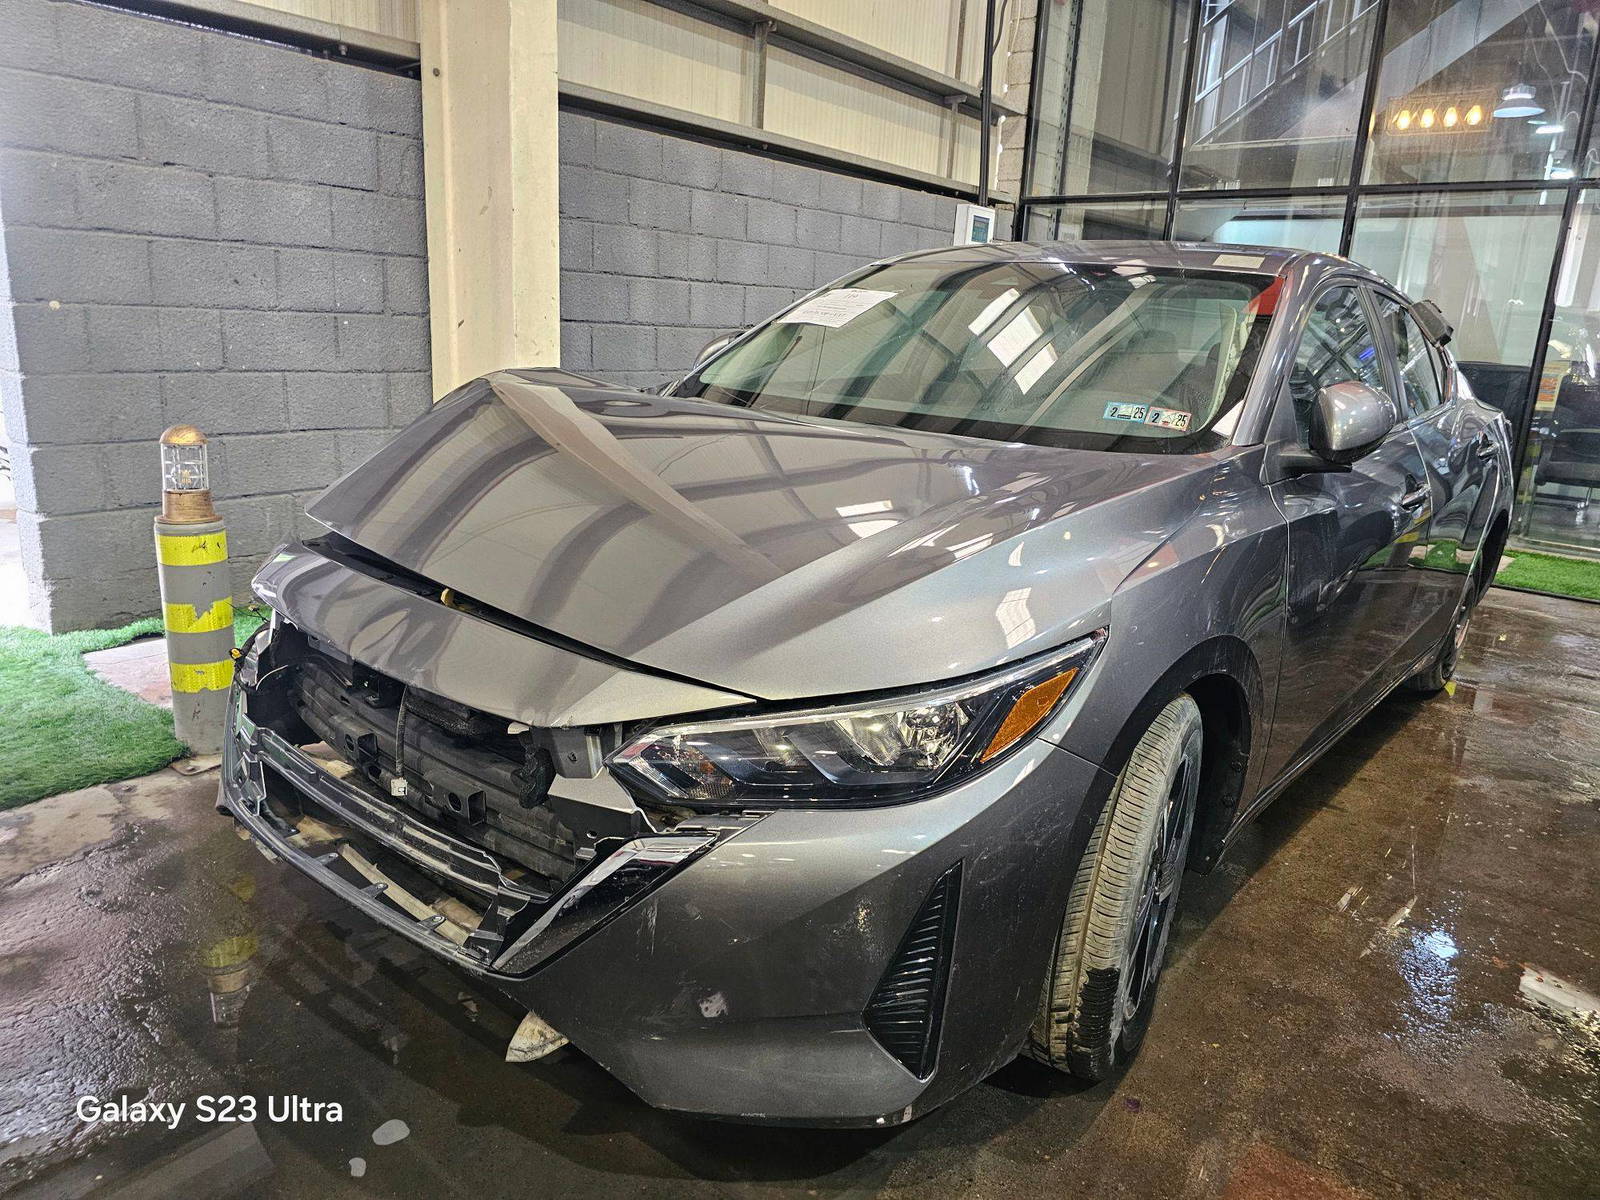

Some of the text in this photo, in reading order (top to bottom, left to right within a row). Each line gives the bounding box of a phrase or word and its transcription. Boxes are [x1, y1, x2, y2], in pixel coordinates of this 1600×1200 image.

[1110, 407, 1118, 417] 2
[1133, 407, 1145, 418] 25
[1152, 413, 1188, 426] 2 25
